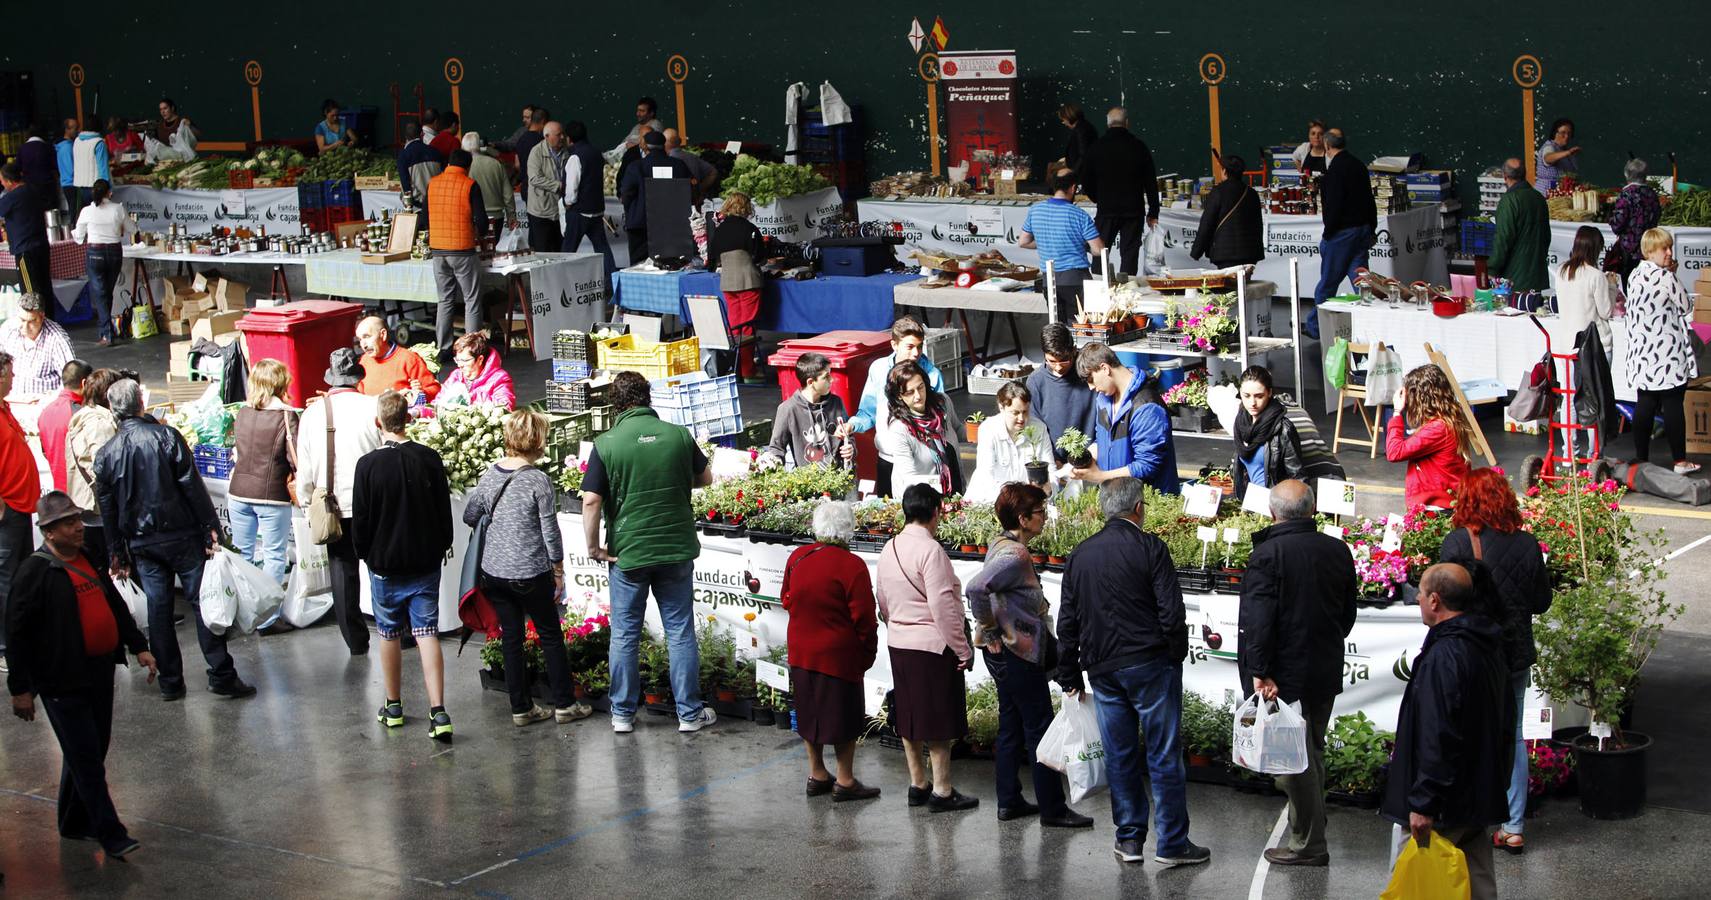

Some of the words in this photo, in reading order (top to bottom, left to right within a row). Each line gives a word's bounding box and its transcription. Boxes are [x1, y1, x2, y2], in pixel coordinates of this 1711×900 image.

[248, 66, 260, 79] 10
[450, 65, 458, 77] 9
[673, 62, 682, 76] 8
[926, 60, 936, 74] 7
[1207, 62, 1218, 76] 6
[1521, 63, 1534, 80] 5
[72, 69, 82, 81] 11
[948, 92, 1010, 103] Peñaquel
[174, 203, 204, 211] Fundación
[755, 212, 794, 224] Fundación
